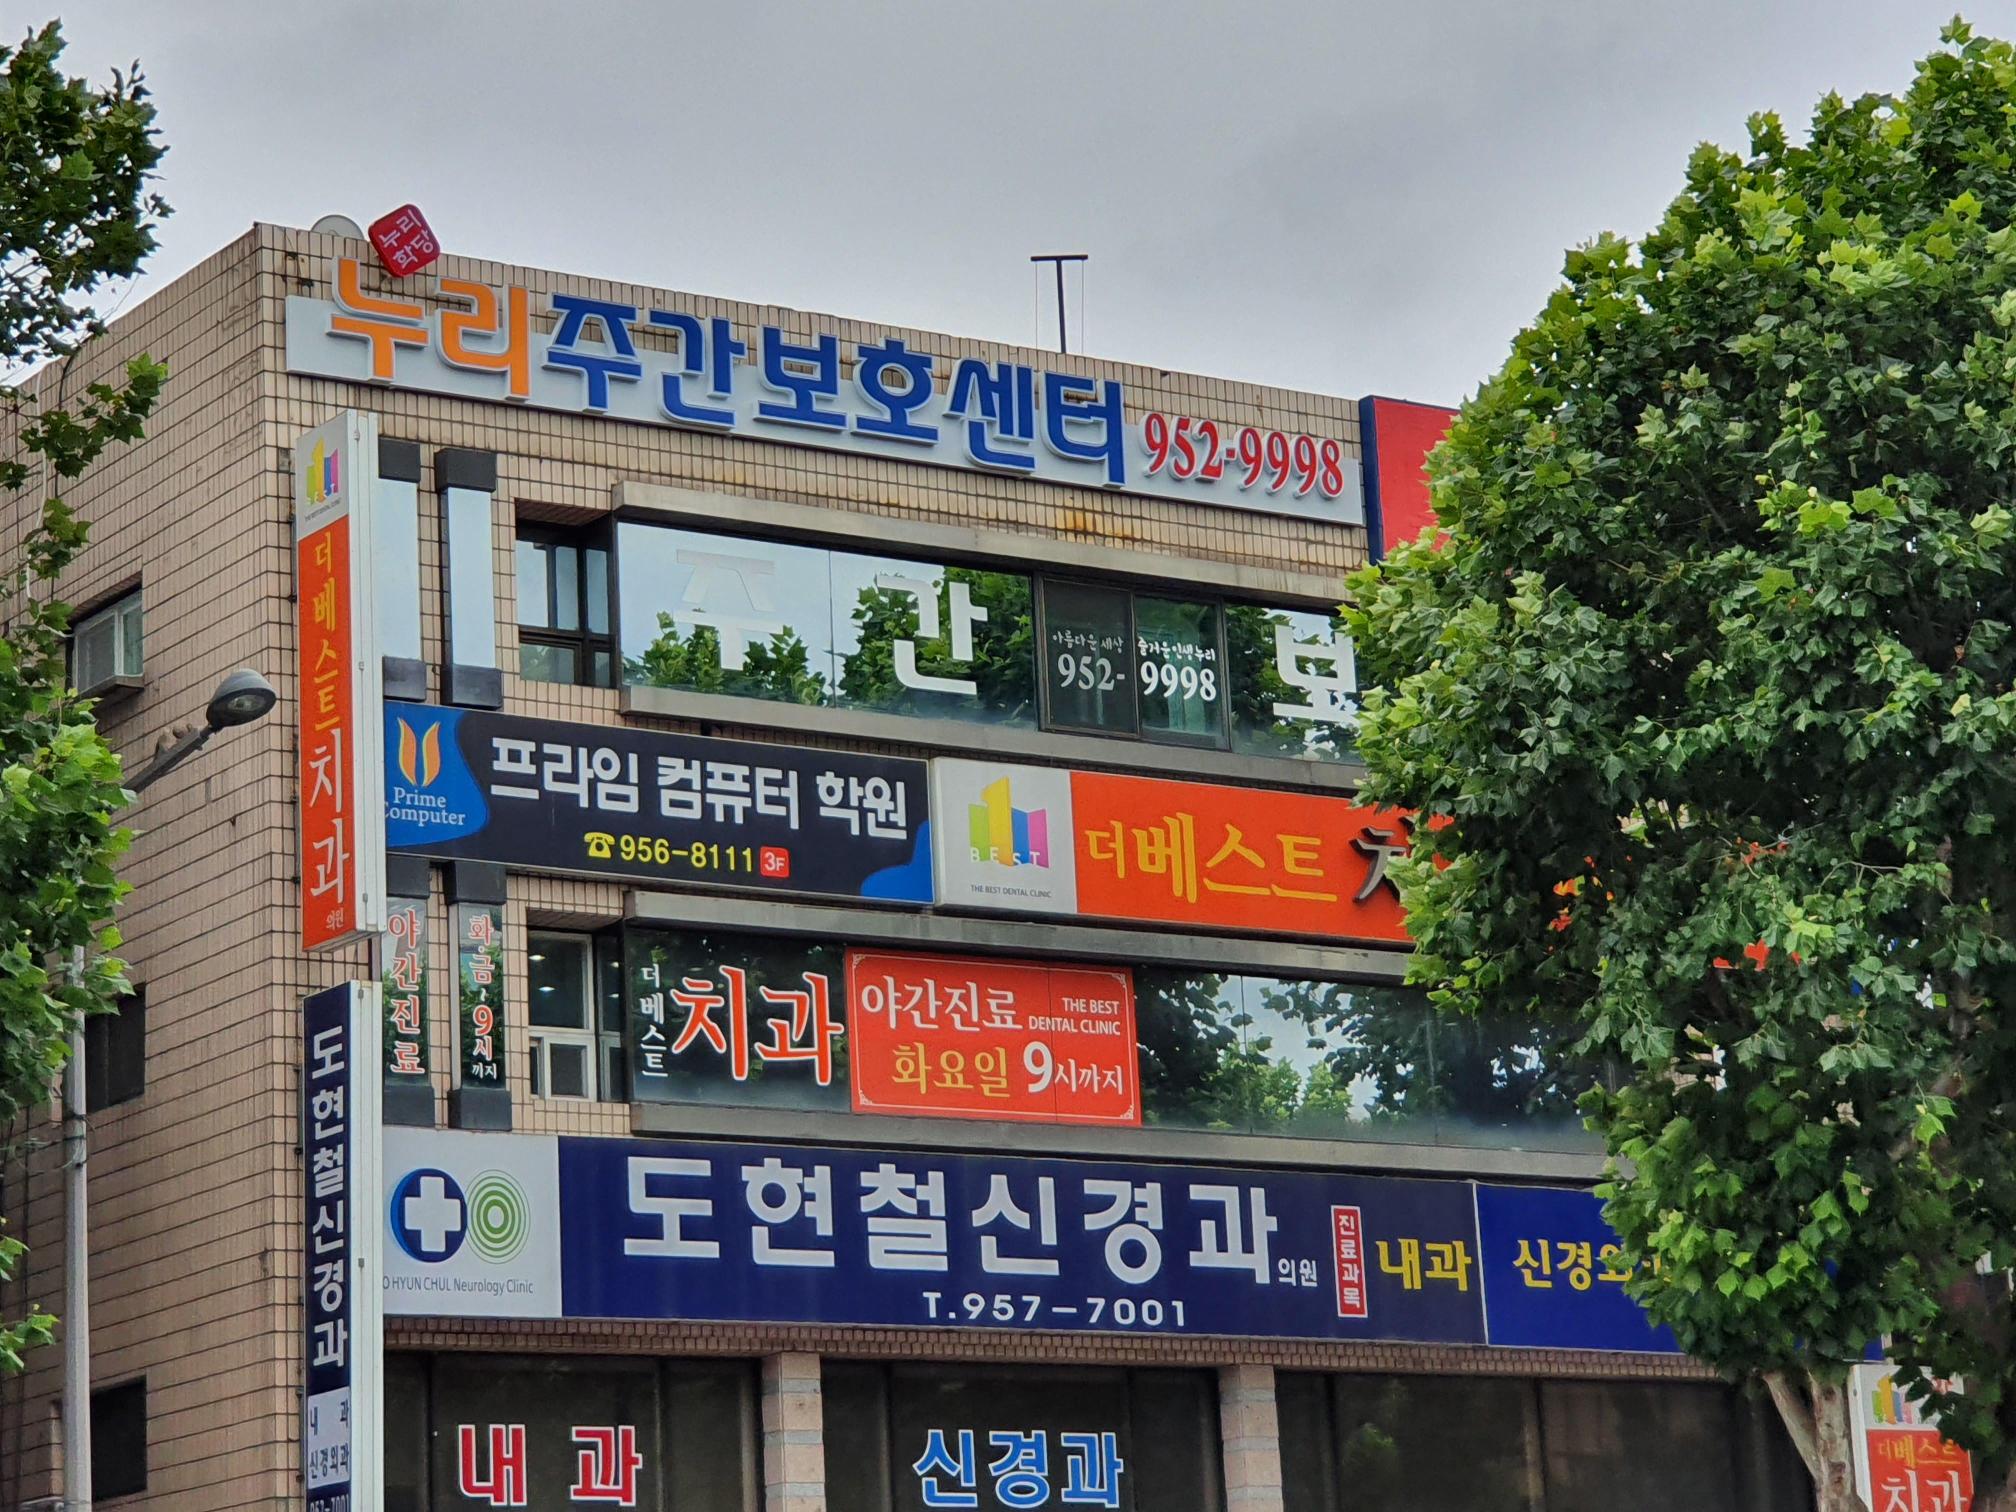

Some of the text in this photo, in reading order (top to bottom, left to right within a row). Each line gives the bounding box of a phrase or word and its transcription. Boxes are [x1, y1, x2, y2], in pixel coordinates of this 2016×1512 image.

[1140, 409, 1346, 499] 952-9998
[393, 786, 447, 808] Prime
[490, 736, 908, 841] 프라임 컴퓨터 학원
[619, 833, 786, 873] 956-8111 3F
[969, 846, 1041, 867] BEST
[1084, 811, 1339, 904] 더베스트
[971, 884, 1052, 899] THE BEST DENTAL CLINIC
[388, 907, 426, 1075] 야간진료
[861, 975, 1024, 1032] 야간진료
[1062, 996, 1121, 1016] THE BEST
[639, 963, 669, 1078] 더베스트
[669, 964, 846, 1087] 치과
[1028, 1015, 1121, 1037] DENTAL CLINIC
[891, 1041, 1011, 1099] 화요일
[311, 1024, 349, 1369] 도현철신경과
[392, 1275, 422, 1291] HYUN
[423, 1276, 451, 1292] CHUL
[453, 1278, 505, 1297] Neurology
[506, 1279, 534, 1294] Clinic
[1338, 1214, 1361, 1309] 진료과목
[1375, 1238, 1473, 1292] 내과
[912, 1428, 1124, 1509] 신경과
